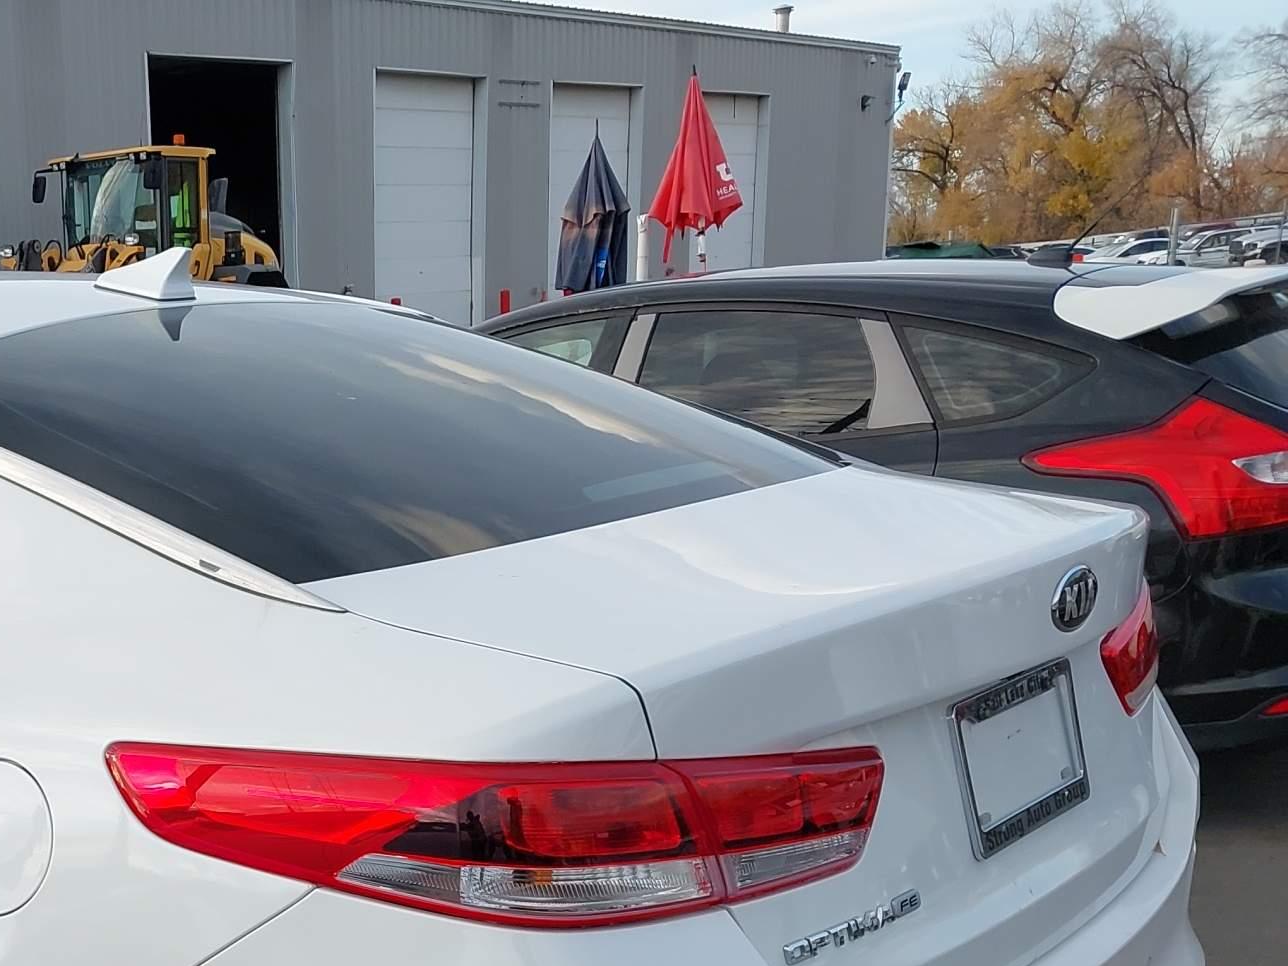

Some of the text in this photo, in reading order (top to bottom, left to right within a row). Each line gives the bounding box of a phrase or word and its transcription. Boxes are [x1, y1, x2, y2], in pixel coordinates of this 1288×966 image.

[1062, 575, 1096, 623] KIA
[985, 781, 1087, 850] Strong Auto Group
[783, 893, 920, 966] OPTIMA FE
